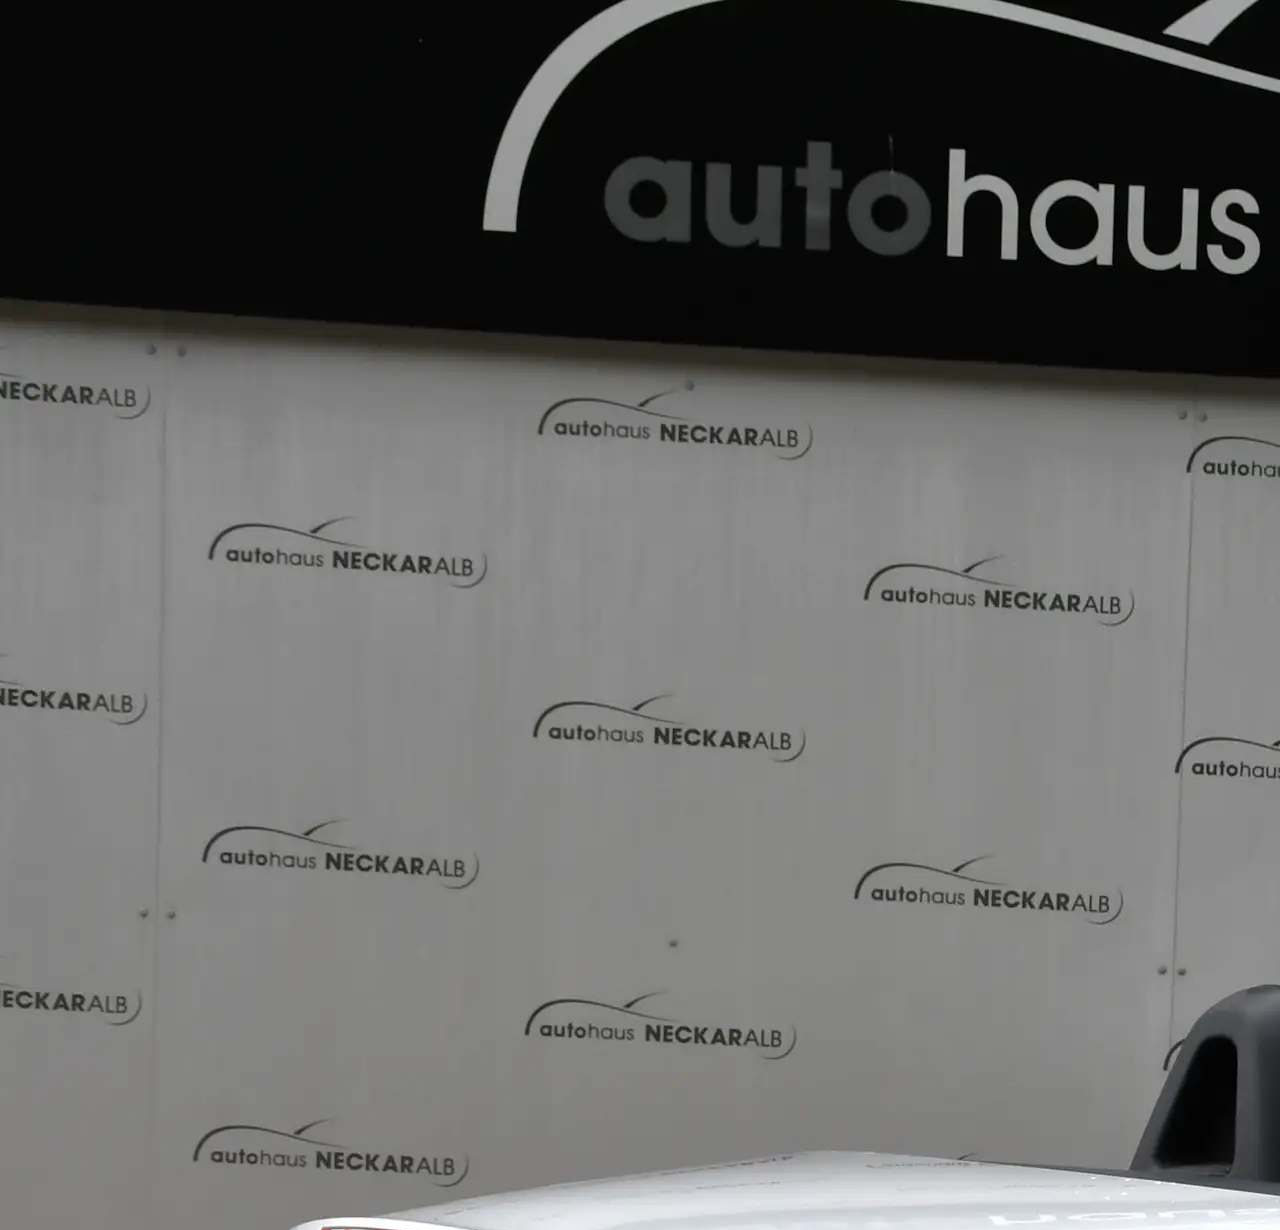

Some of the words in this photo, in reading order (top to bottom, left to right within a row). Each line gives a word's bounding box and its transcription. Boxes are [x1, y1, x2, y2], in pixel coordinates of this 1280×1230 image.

[605, 140, 1260, 274] autohaus
[554, 420, 650, 439] autohaus
[660, 424, 799, 449] NECKARALB
[226, 547, 324, 567] autohaus
[332, 550, 473, 577] NECKARALB
[881, 586, 976, 607] autohaus
[984, 589, 1120, 615] NECKARALB
[548, 725, 644, 743] autohaus
[654, 727, 792, 751] NECKARALB
[219, 850, 317, 869] autohaus
[325, 852, 465, 878] NECKARALB
[871, 886, 965, 905] autohaus
[973, 888, 1109, 914] NECKARALB
[540, 1022, 634, 1041] autohaus
[645, 1024, 782, 1049] NECKARALB
[211, 1149, 307, 1167] autohaus
[316, 1151, 455, 1176] NECKARALB
